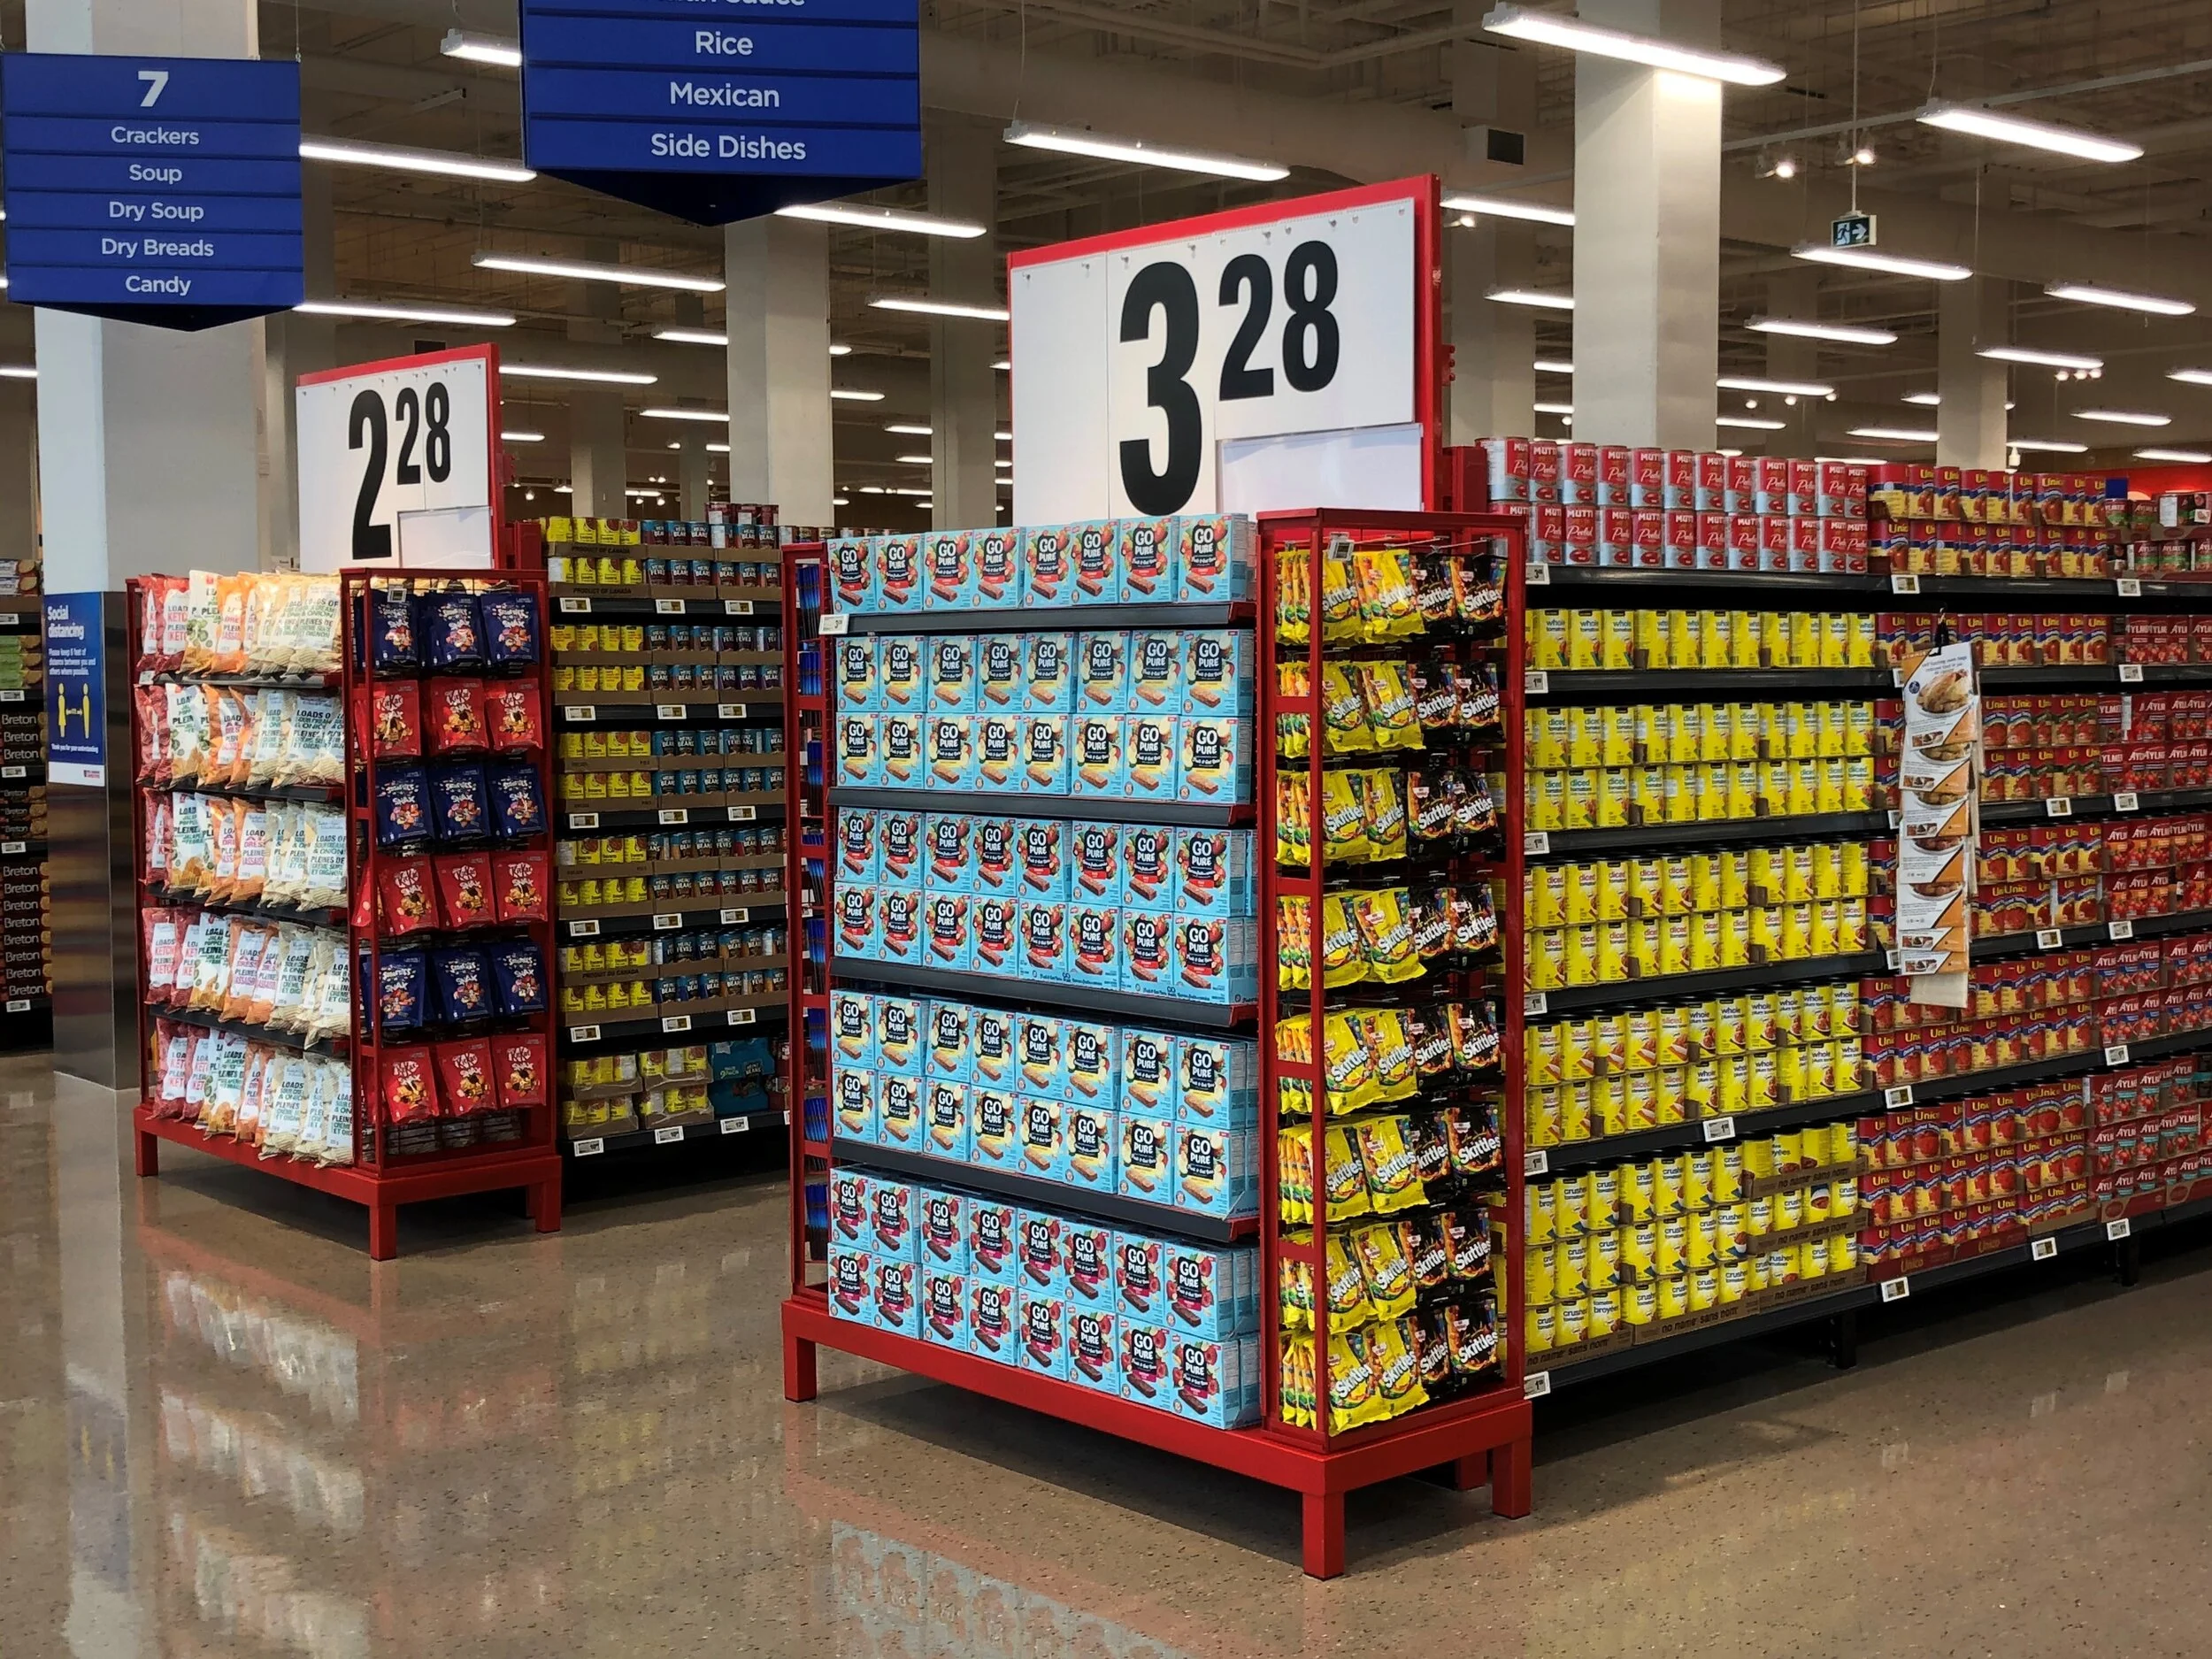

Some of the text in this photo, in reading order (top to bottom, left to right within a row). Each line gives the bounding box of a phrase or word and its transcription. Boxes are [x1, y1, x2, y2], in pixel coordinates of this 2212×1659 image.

[695, 30, 754, 56] Rice
[137, 70, 169, 107] 7
[670, 81, 780, 107] Mexican
[111, 126, 200, 145] Crackers
[650, 133, 807, 160] Side Dishes
[129, 164, 182, 185] Soup
[109, 201, 204, 222] Dry Soup
[101, 238, 214, 258] Dry Breads
[125, 275, 191, 296] Candy
[1119, 240, 1340, 517] 3 28
[349, 382, 450, 560] 2 28
[1135, 531, 1154, 545] GO
[1194, 528, 1214, 542] GO
[939, 543, 956, 557] GO
[1039, 538, 1056, 552] GO
[1134, 545, 1154, 555] PURE
[1194, 542, 1213, 553] PURE
[841, 549, 857, 562] GO
[939, 556, 956, 565] PURE
[1039, 552, 1056, 562] PURE
[841, 562, 858, 572] PURE
[1417, 588, 1454, 611] Skittles
[1464, 588, 1502, 611] Skittles
[48, 605, 68, 620] Social
[49, 622, 84, 640] distancing
[1147, 642, 1166, 657] GO
[1199, 642, 1219, 657] GO
[1146, 657, 1165, 666] PURE
[1198, 657, 1219, 667] PURE
[1417, 694, 1456, 719] Skittles
[1460, 693, 1499, 718] Skittles
[2, 713, 37, 726] Breton
[4, 732, 39, 743] Breton
[1141, 727, 1159, 741] GO
[1196, 730, 1217, 745] GO
[1140, 741, 1159, 751] PURE
[1195, 745, 1217, 755] PURE
[4, 749, 39, 761] Breton
[1456, 796, 1493, 824] Skittles
[1138, 838, 1156, 852] GO
[1137, 851, 1155, 862] PURE
[3, 866, 37, 877] Breton
[4, 883, 39, 895] Breton
[4, 918, 39, 928] Breton
[4, 933, 39, 946] Breton
[1414, 919, 1451, 949] Skittles
[6, 967, 41, 979] Breton
[10, 984, 43, 996] Breton
[1078, 1035, 1095, 1050] GO
[1462, 1032, 1499, 1060] Skittles
[1078, 1049, 1095, 1060] PURE
[1137, 1044, 1156, 1059] GO
[1415, 1037, 1451, 1066] Skittles
[1137, 1059, 1156, 1069] PURE
[1191, 1138, 1210, 1155] GO
[1459, 1136, 1501, 1164] Skittles
[1190, 1154, 1210, 1164] PURE
[1417, 1143, 1448, 1170] kittles
[1377, 1150, 1416, 1183] Skittles
[841, 1184, 856, 1197] GO
[841, 1197, 856, 1206] PURE
[1076, 1237, 1094, 1253] GO
[1076, 1251, 1094, 1263] PURE
[1127, 1248, 1146, 1264] GO
[1455, 1240, 1491, 1271] Skittles
[841, 1259, 857, 1273] GO
[1127, 1263, 1146, 1274] PURE
[1179, 1261, 1198, 1278] GO
[1414, 1248, 1445, 1279] Skittle
[841, 1272, 857, 1282] PURE
[1179, 1277, 1199, 1288] PURE
[1700, 1313, 1719, 1323] sans
[1720, 1307, 1738, 1317] nom
[1458, 1332, 1498, 1363] Skittles
[1383, 1351, 1416, 1388] Skittles
